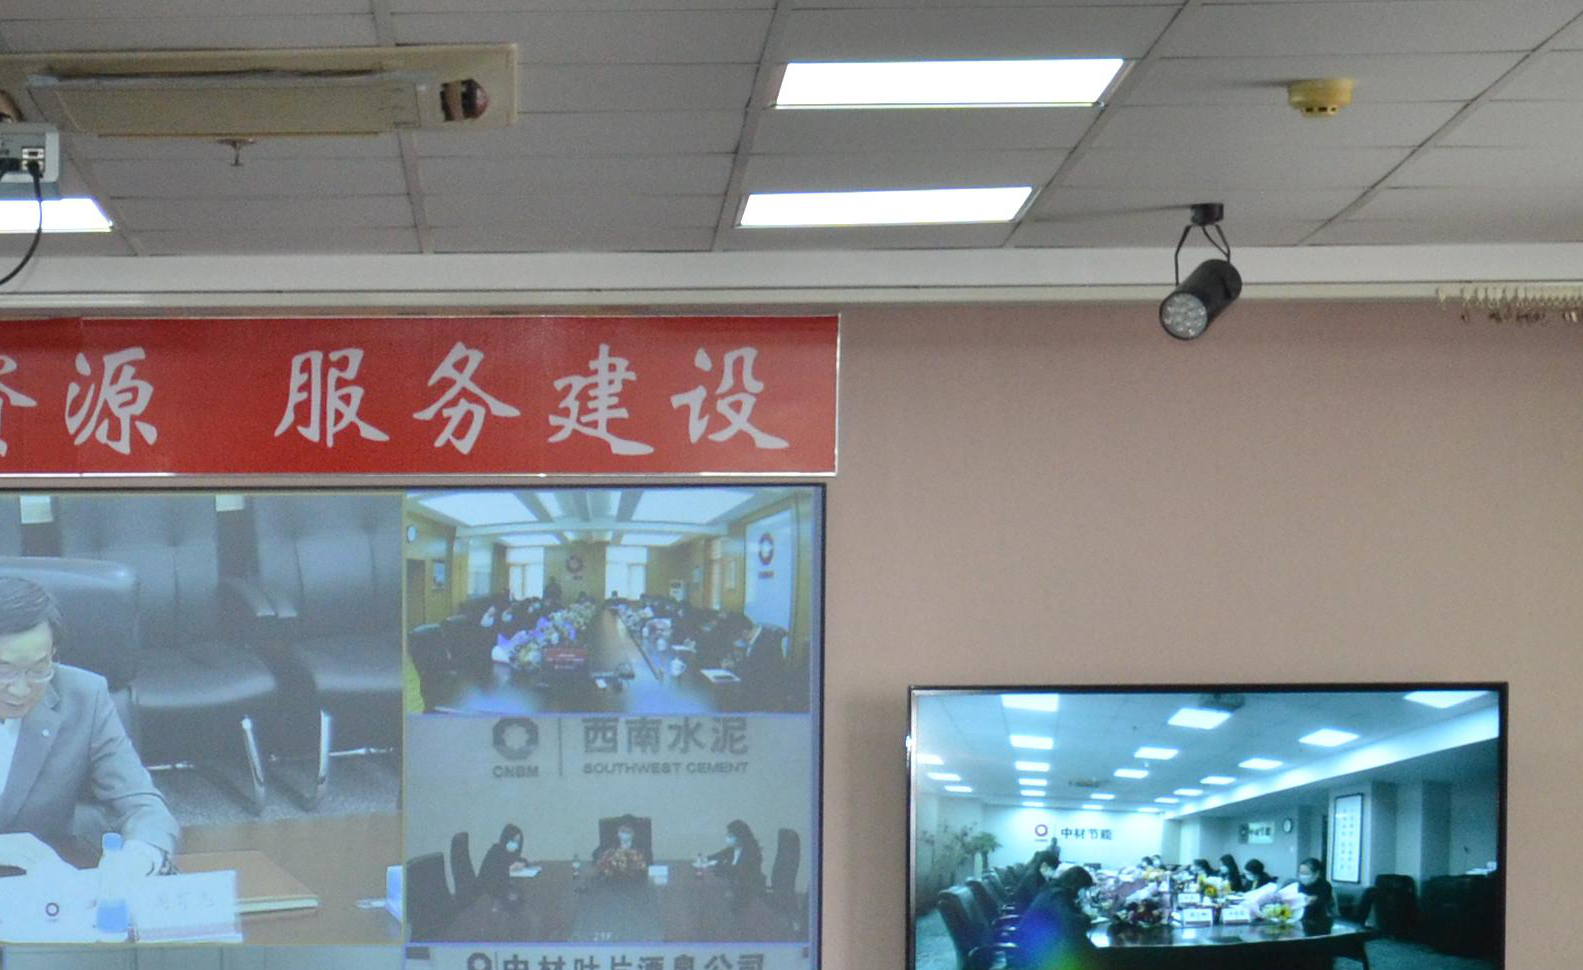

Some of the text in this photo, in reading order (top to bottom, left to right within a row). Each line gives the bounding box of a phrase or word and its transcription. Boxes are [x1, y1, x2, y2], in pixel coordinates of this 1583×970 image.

[274, 341, 790, 456] 服务建设
[582, 717, 749, 755] 西南水泥
[492, 765, 540, 778] CNBM
[583, 761, 749, 775] SOUTHWEST CEMENT
